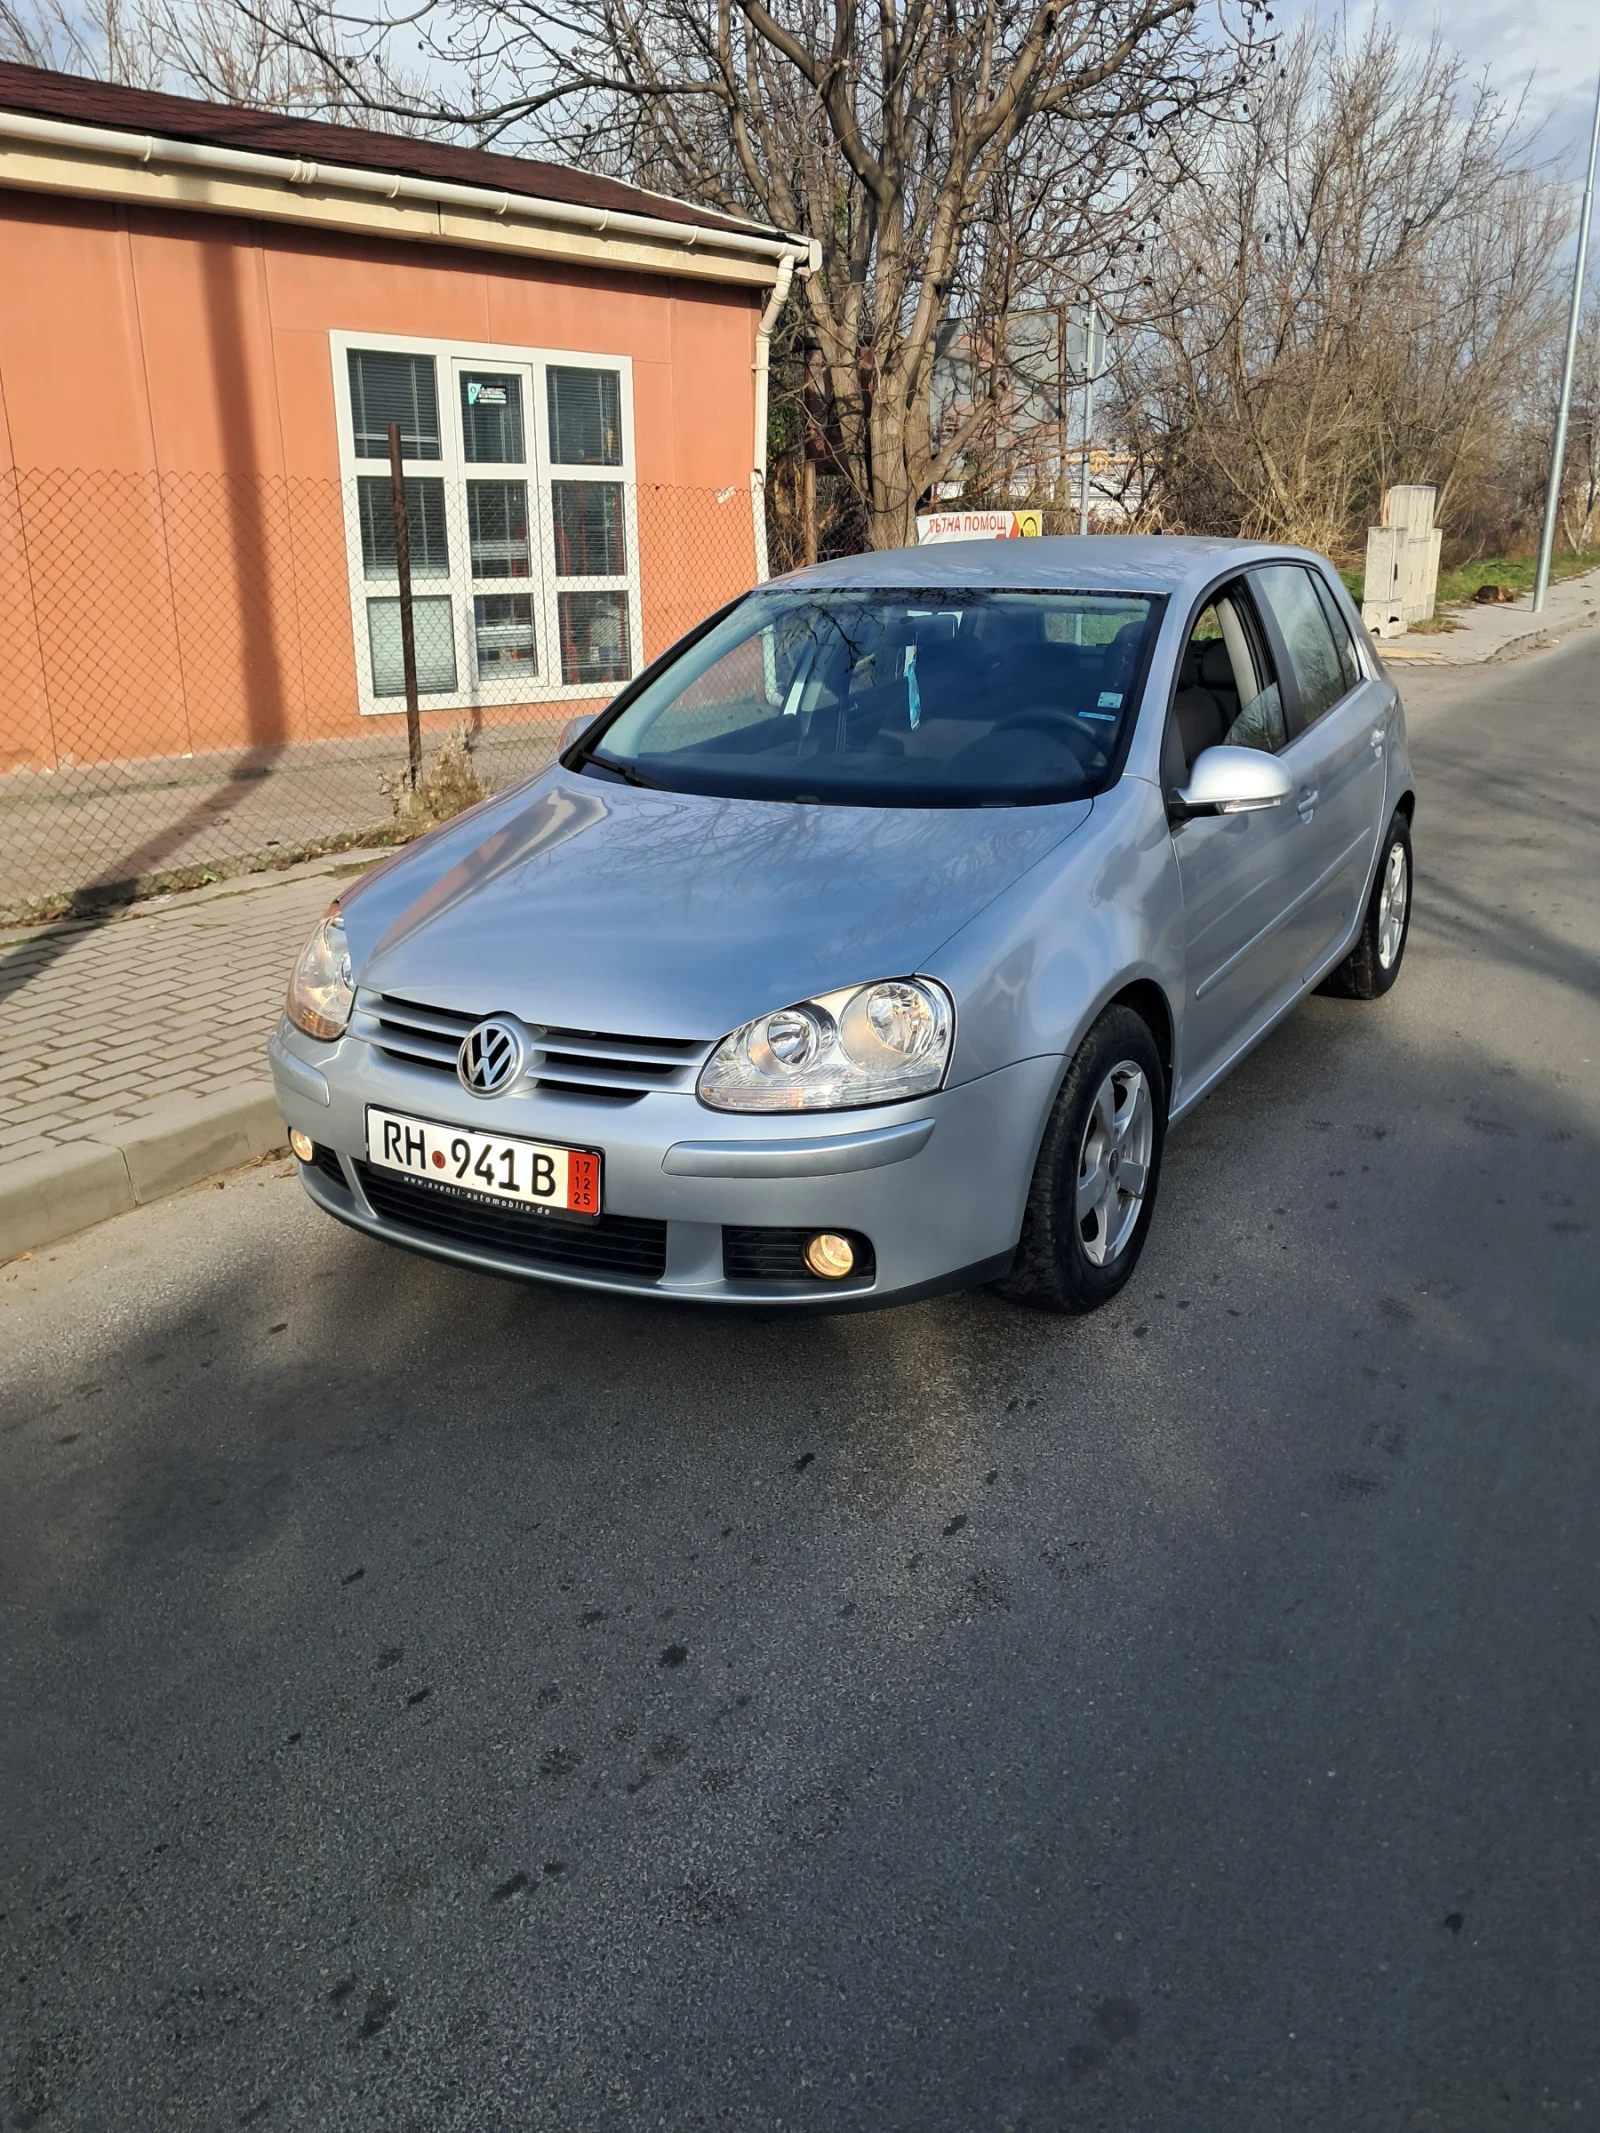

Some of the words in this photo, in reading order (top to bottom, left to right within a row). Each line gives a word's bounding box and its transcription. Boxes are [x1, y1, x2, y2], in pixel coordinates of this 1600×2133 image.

[964, 515, 1006, 531] ПОМОЩ
[384, 1120, 426, 1170] RH
[451, 1138, 520, 1192] 941
[531, 1153, 556, 1197] B
[575, 1160, 590, 1174] 17
[575, 1176, 590, 1190] 12
[403, 1175, 550, 1215] www.aventi-automobile.de
[574, 1191, 590, 1206] 25
